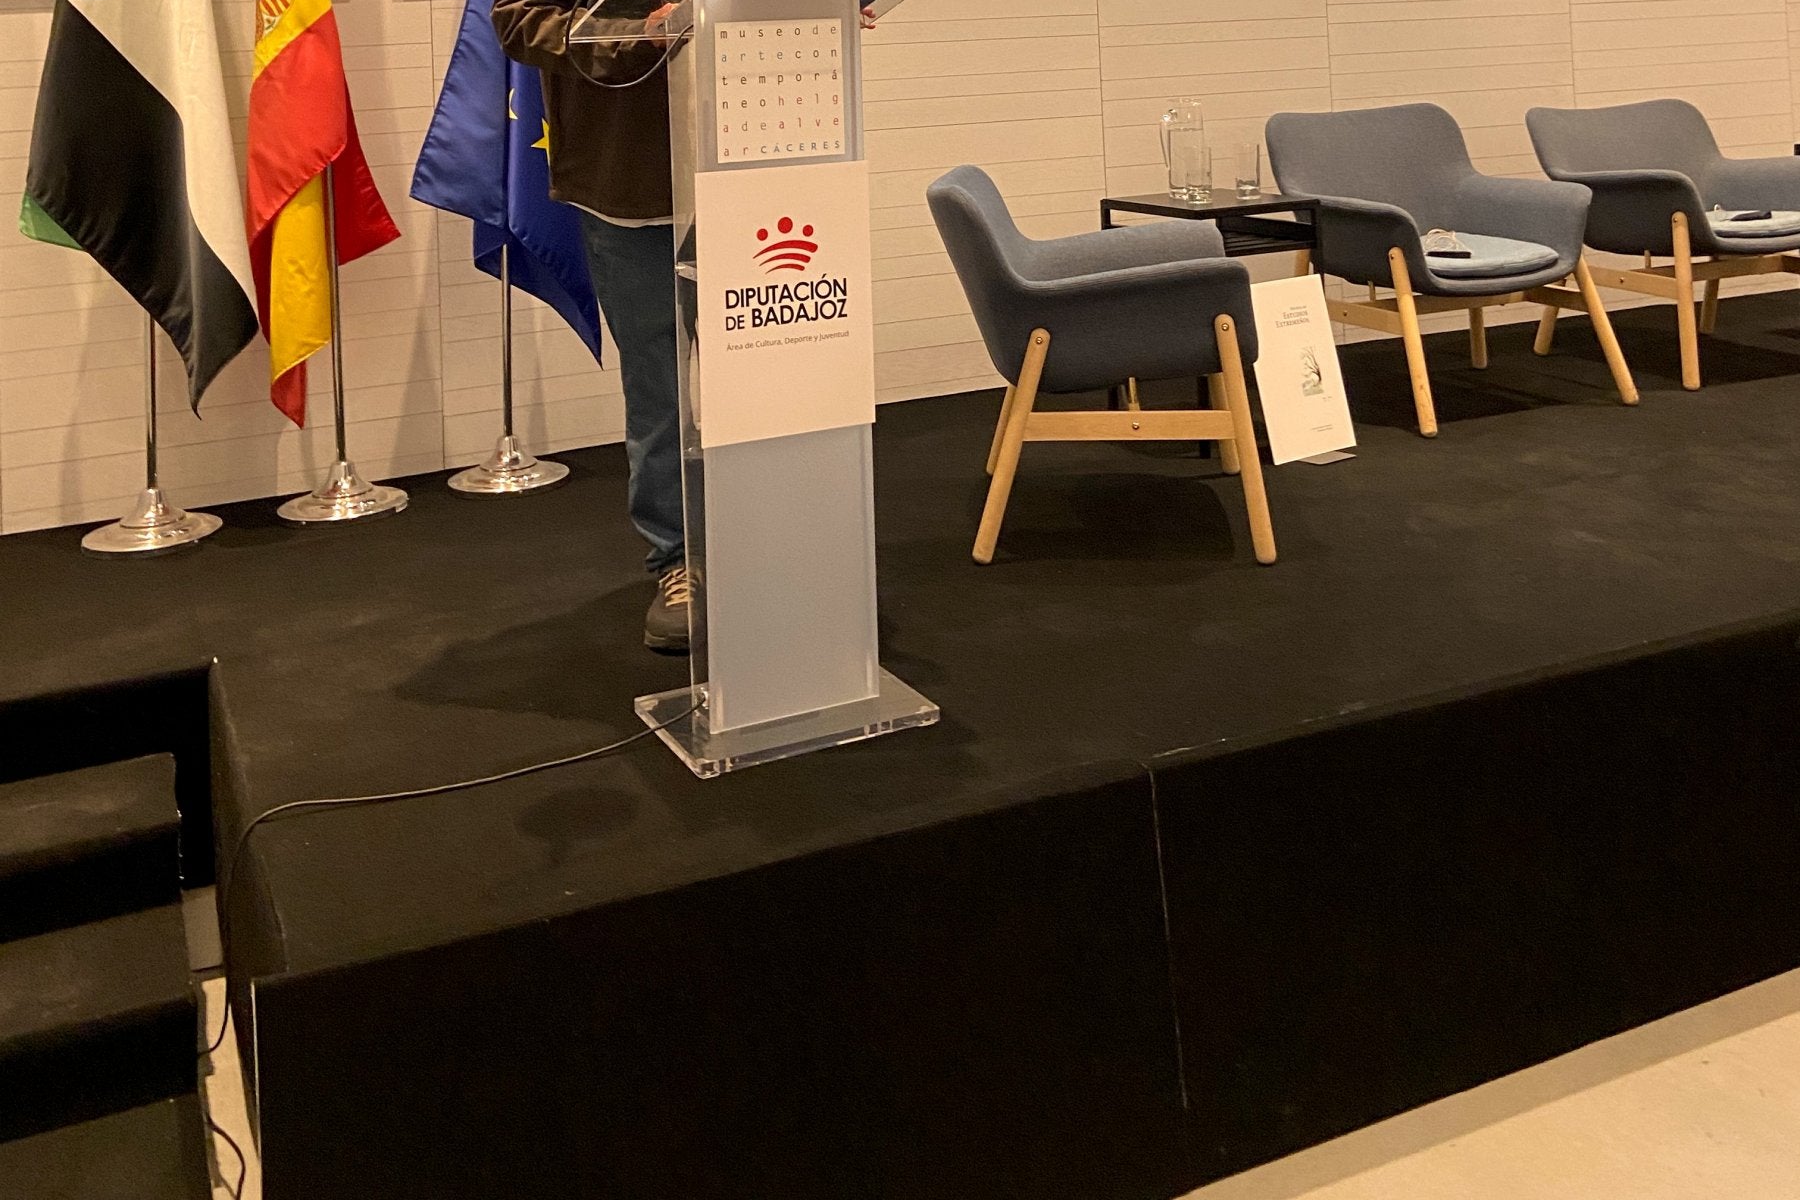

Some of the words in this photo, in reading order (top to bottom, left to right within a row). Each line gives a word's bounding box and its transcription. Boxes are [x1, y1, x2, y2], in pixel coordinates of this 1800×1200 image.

[725, 273, 847, 309] DIPUTACIÓN
[725, 315, 745, 331] DE
[751, 298, 848, 328] BADAJOZ
[726, 343, 744, 351] Área
[755, 339, 783, 348] Cultura,
[784, 335, 814, 344] Deporte
[819, 330, 849, 342] Juventud
